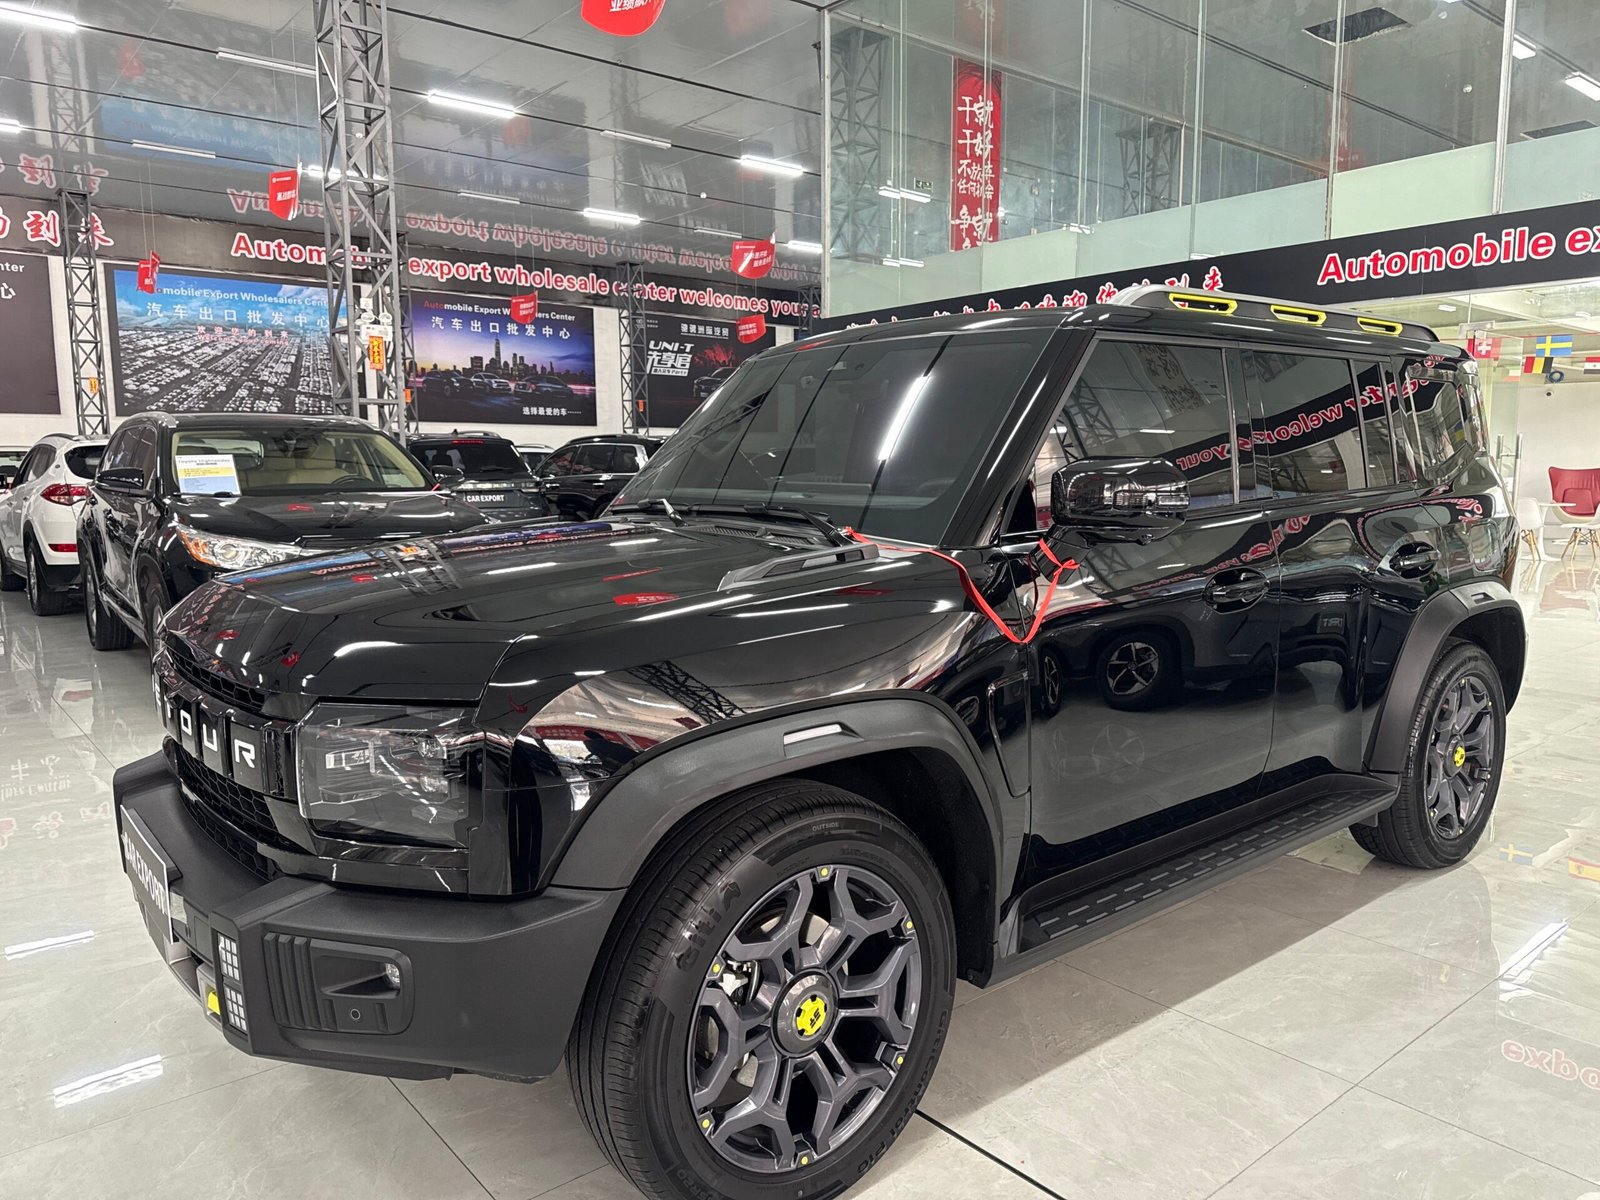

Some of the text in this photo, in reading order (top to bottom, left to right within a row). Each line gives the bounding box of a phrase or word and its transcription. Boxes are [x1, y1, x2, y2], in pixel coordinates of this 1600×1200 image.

[1316, 226, 1557, 286] Automobile
[203, 289, 239, 301] Export
[240, 291, 302, 306] Wholesalers
[407, 257, 493, 282] export
[494, 264, 610, 296] wholesale
[679, 286, 769, 314] welcomes
[770, 299, 809, 318] your
[146, 301, 329, 328] 汽车出口批发中心
[423, 300, 473, 313] Automobile
[474, 305, 501, 316] Export
[550, 311, 576, 322] Center
[431, 315, 571, 340] 汽车出口批发中心
[648, 340, 695, 353] UNI-T
[466, 493, 505, 503] CAR EXPORT
[812, 821, 840, 832] OUTSIDE
